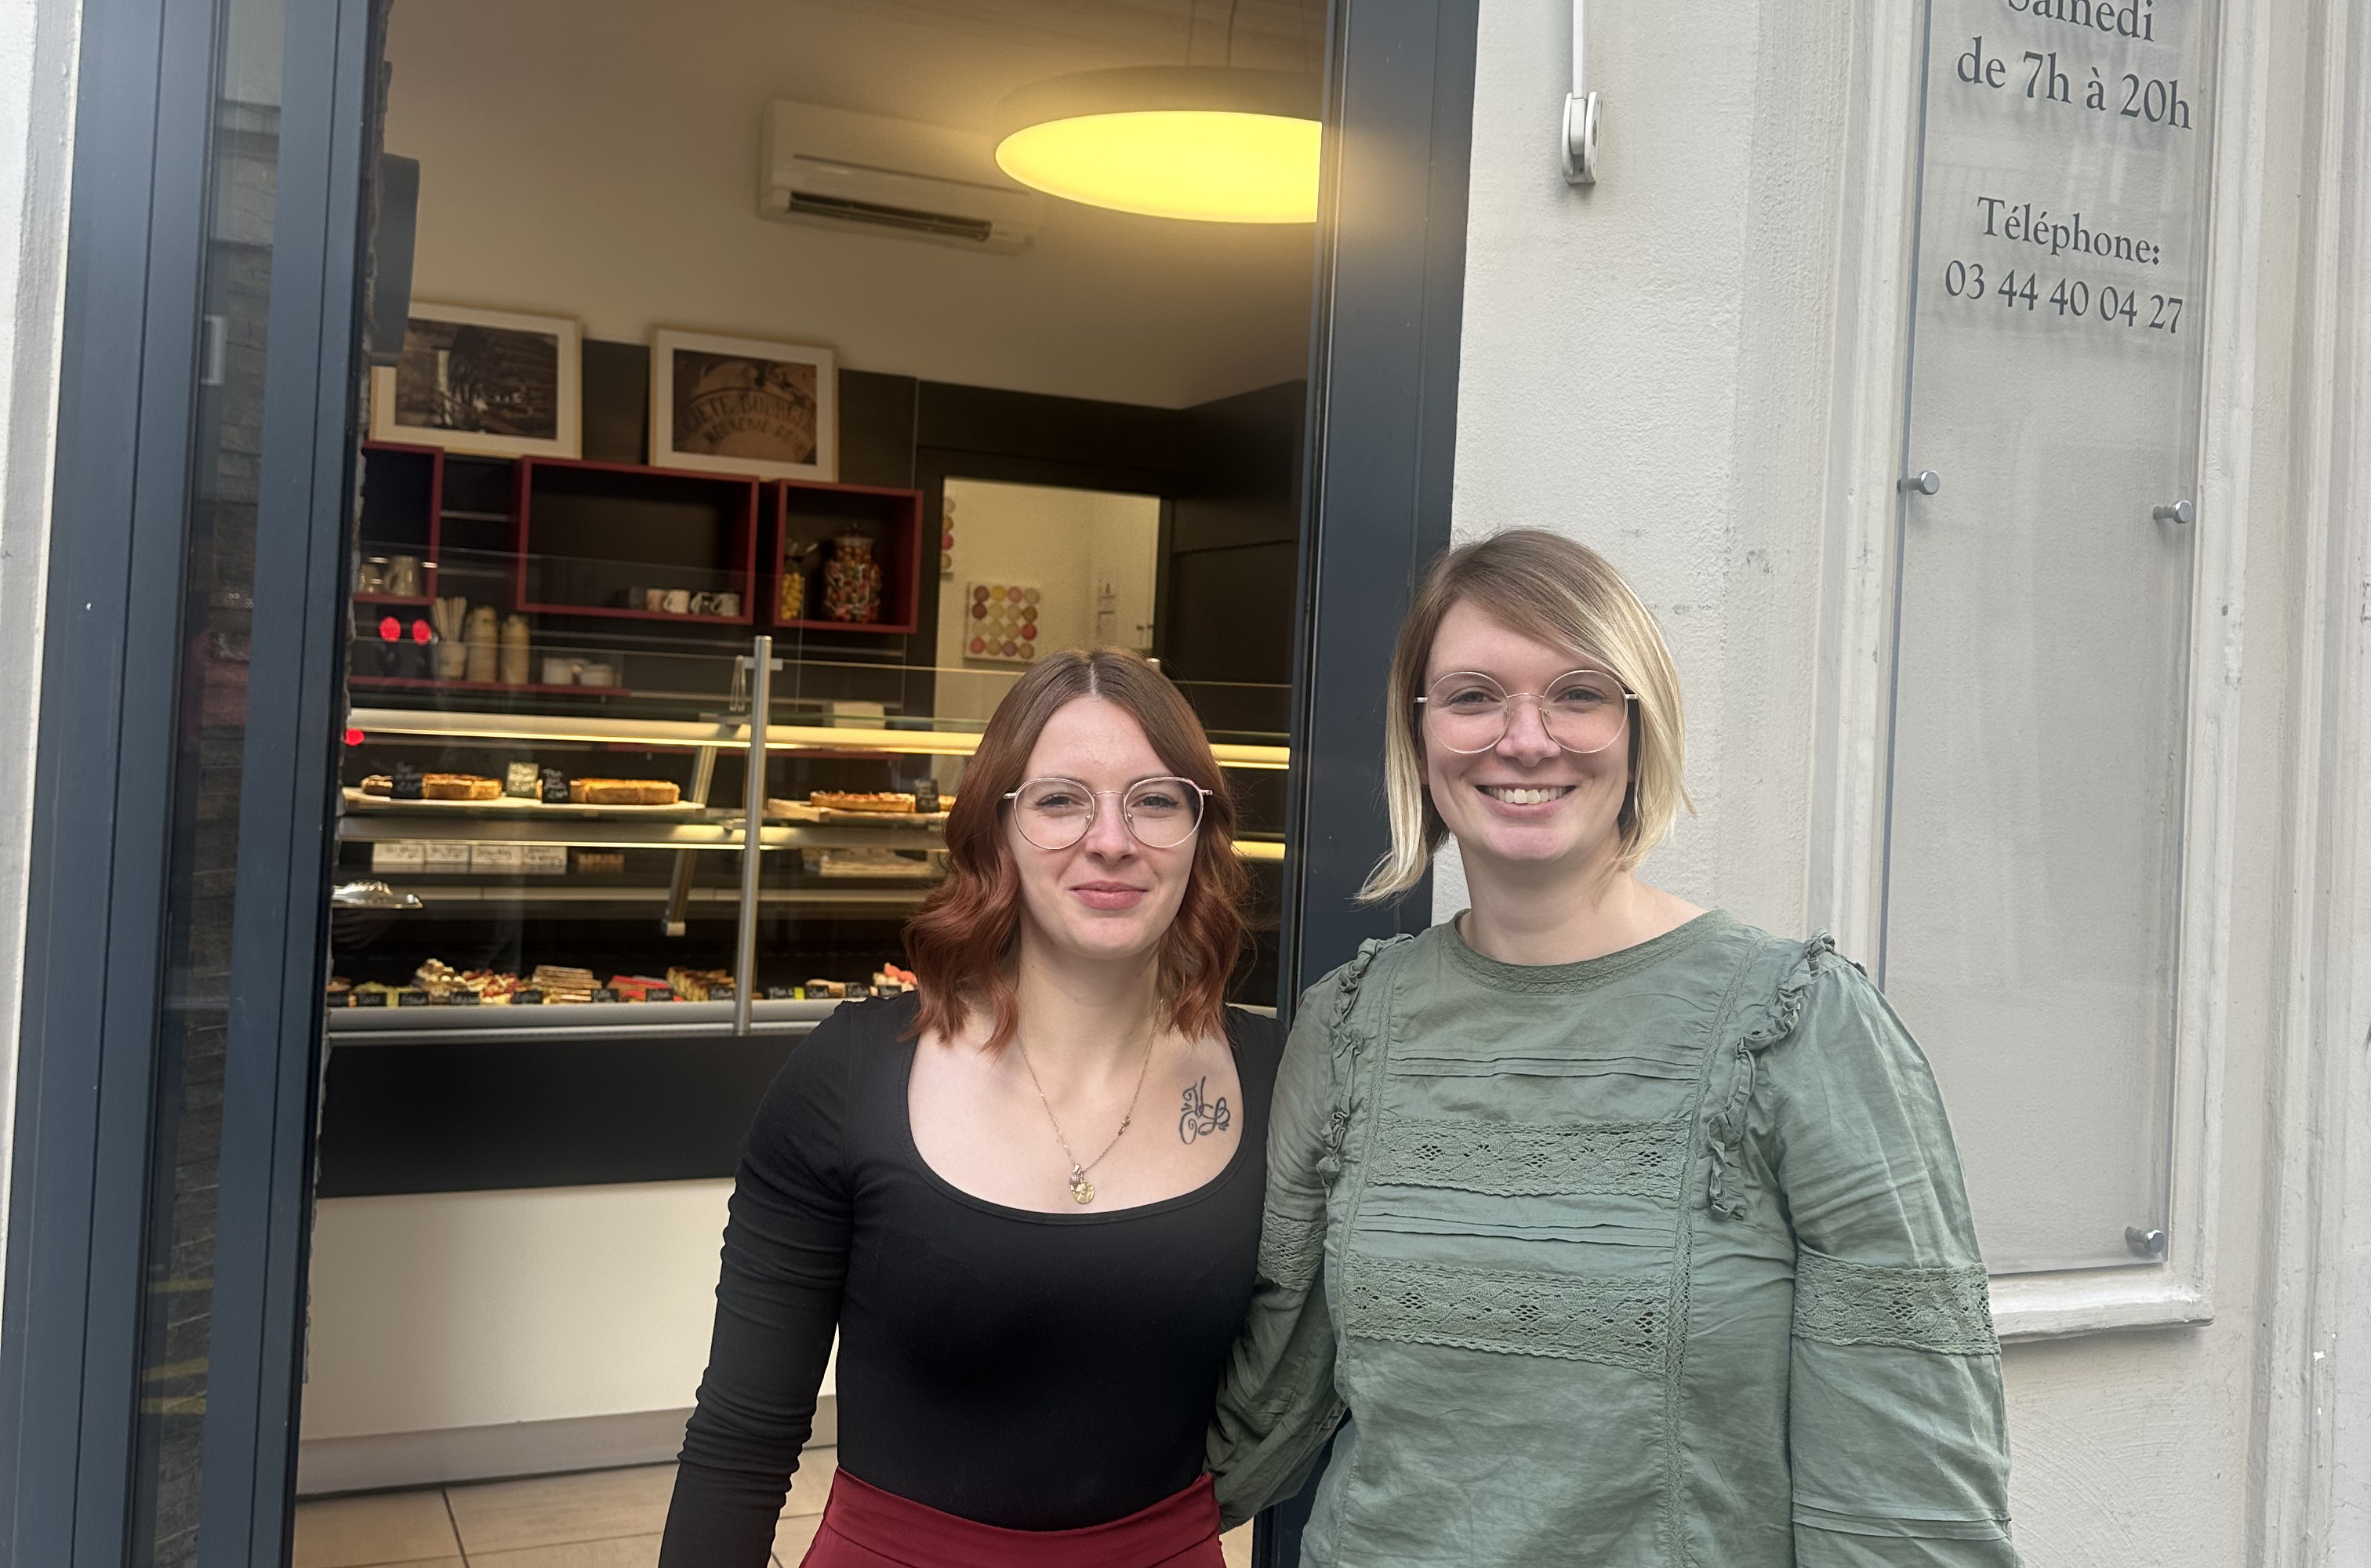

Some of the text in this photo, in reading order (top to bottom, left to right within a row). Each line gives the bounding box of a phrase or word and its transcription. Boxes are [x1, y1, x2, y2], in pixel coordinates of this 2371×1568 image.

[2008, 0, 2155, 42] amedi
[1957, 36, 2193, 130] de 7h à 20h
[1977, 196, 2160, 266] Téléphone:
[1945, 260, 2184, 334] 03 44 40 04 27
